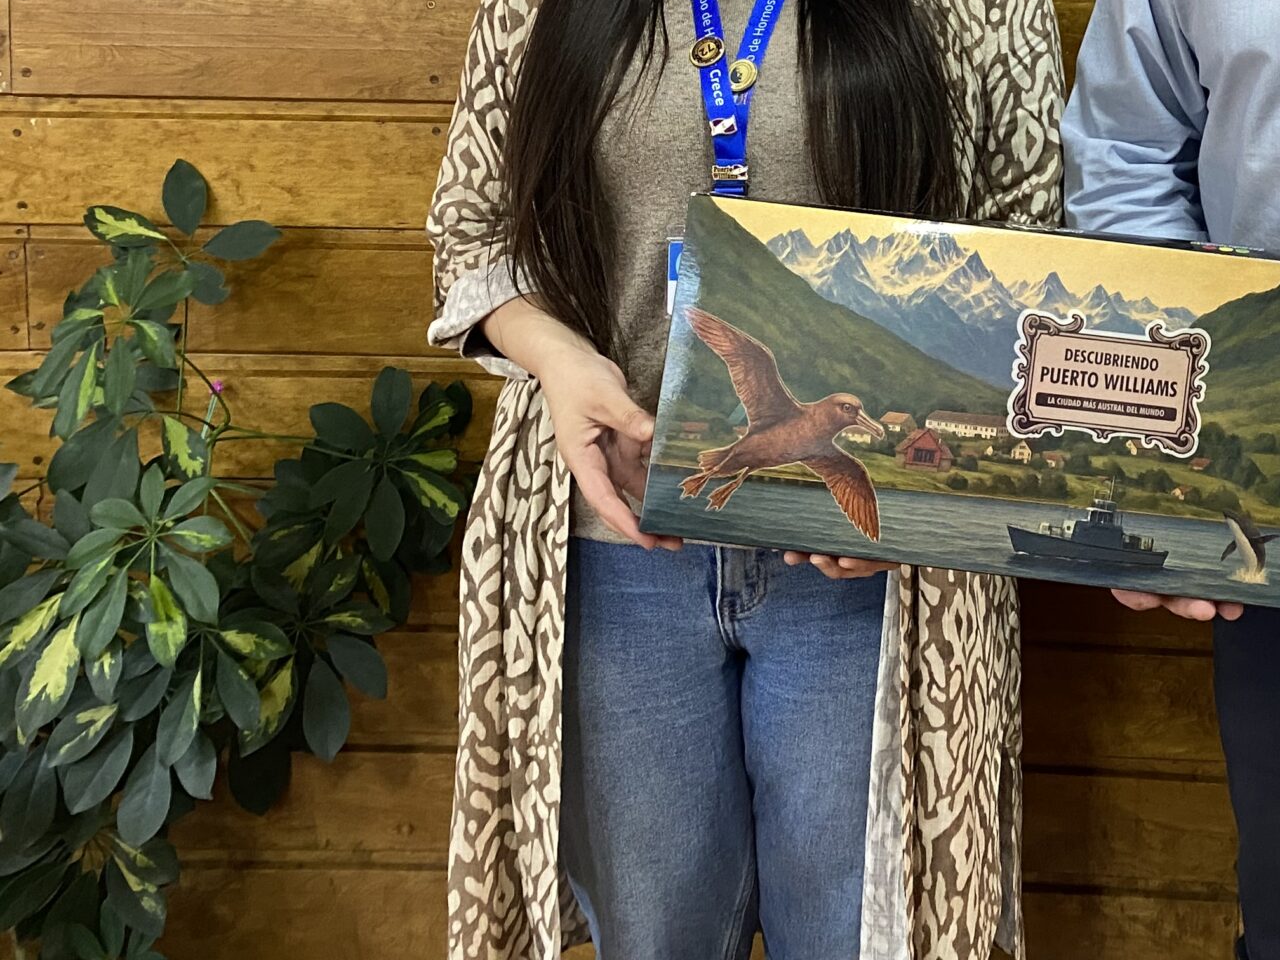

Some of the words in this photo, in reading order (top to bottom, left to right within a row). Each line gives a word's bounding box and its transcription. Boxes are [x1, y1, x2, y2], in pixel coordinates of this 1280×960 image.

[701, 12, 713, 27] de
[752, 0, 776, 36] Hornos
[748, 38, 761, 52] de
[709, 69, 725, 106] Crece
[1064, 348, 1159, 372] DESCUBRIENDO
[1039, 366, 1099, 388] PUERTO
[1104, 373, 1178, 398] WILLIAMS
[1047, 396, 1056, 405] LA
[1057, 398, 1081, 408] CIUDAD
[1083, 398, 1096, 410] MÁS
[1097, 401, 1125, 413] AUSTRAL
[1126, 405, 1138, 414] DEL
[1139, 406, 1165, 417] MUNDO
